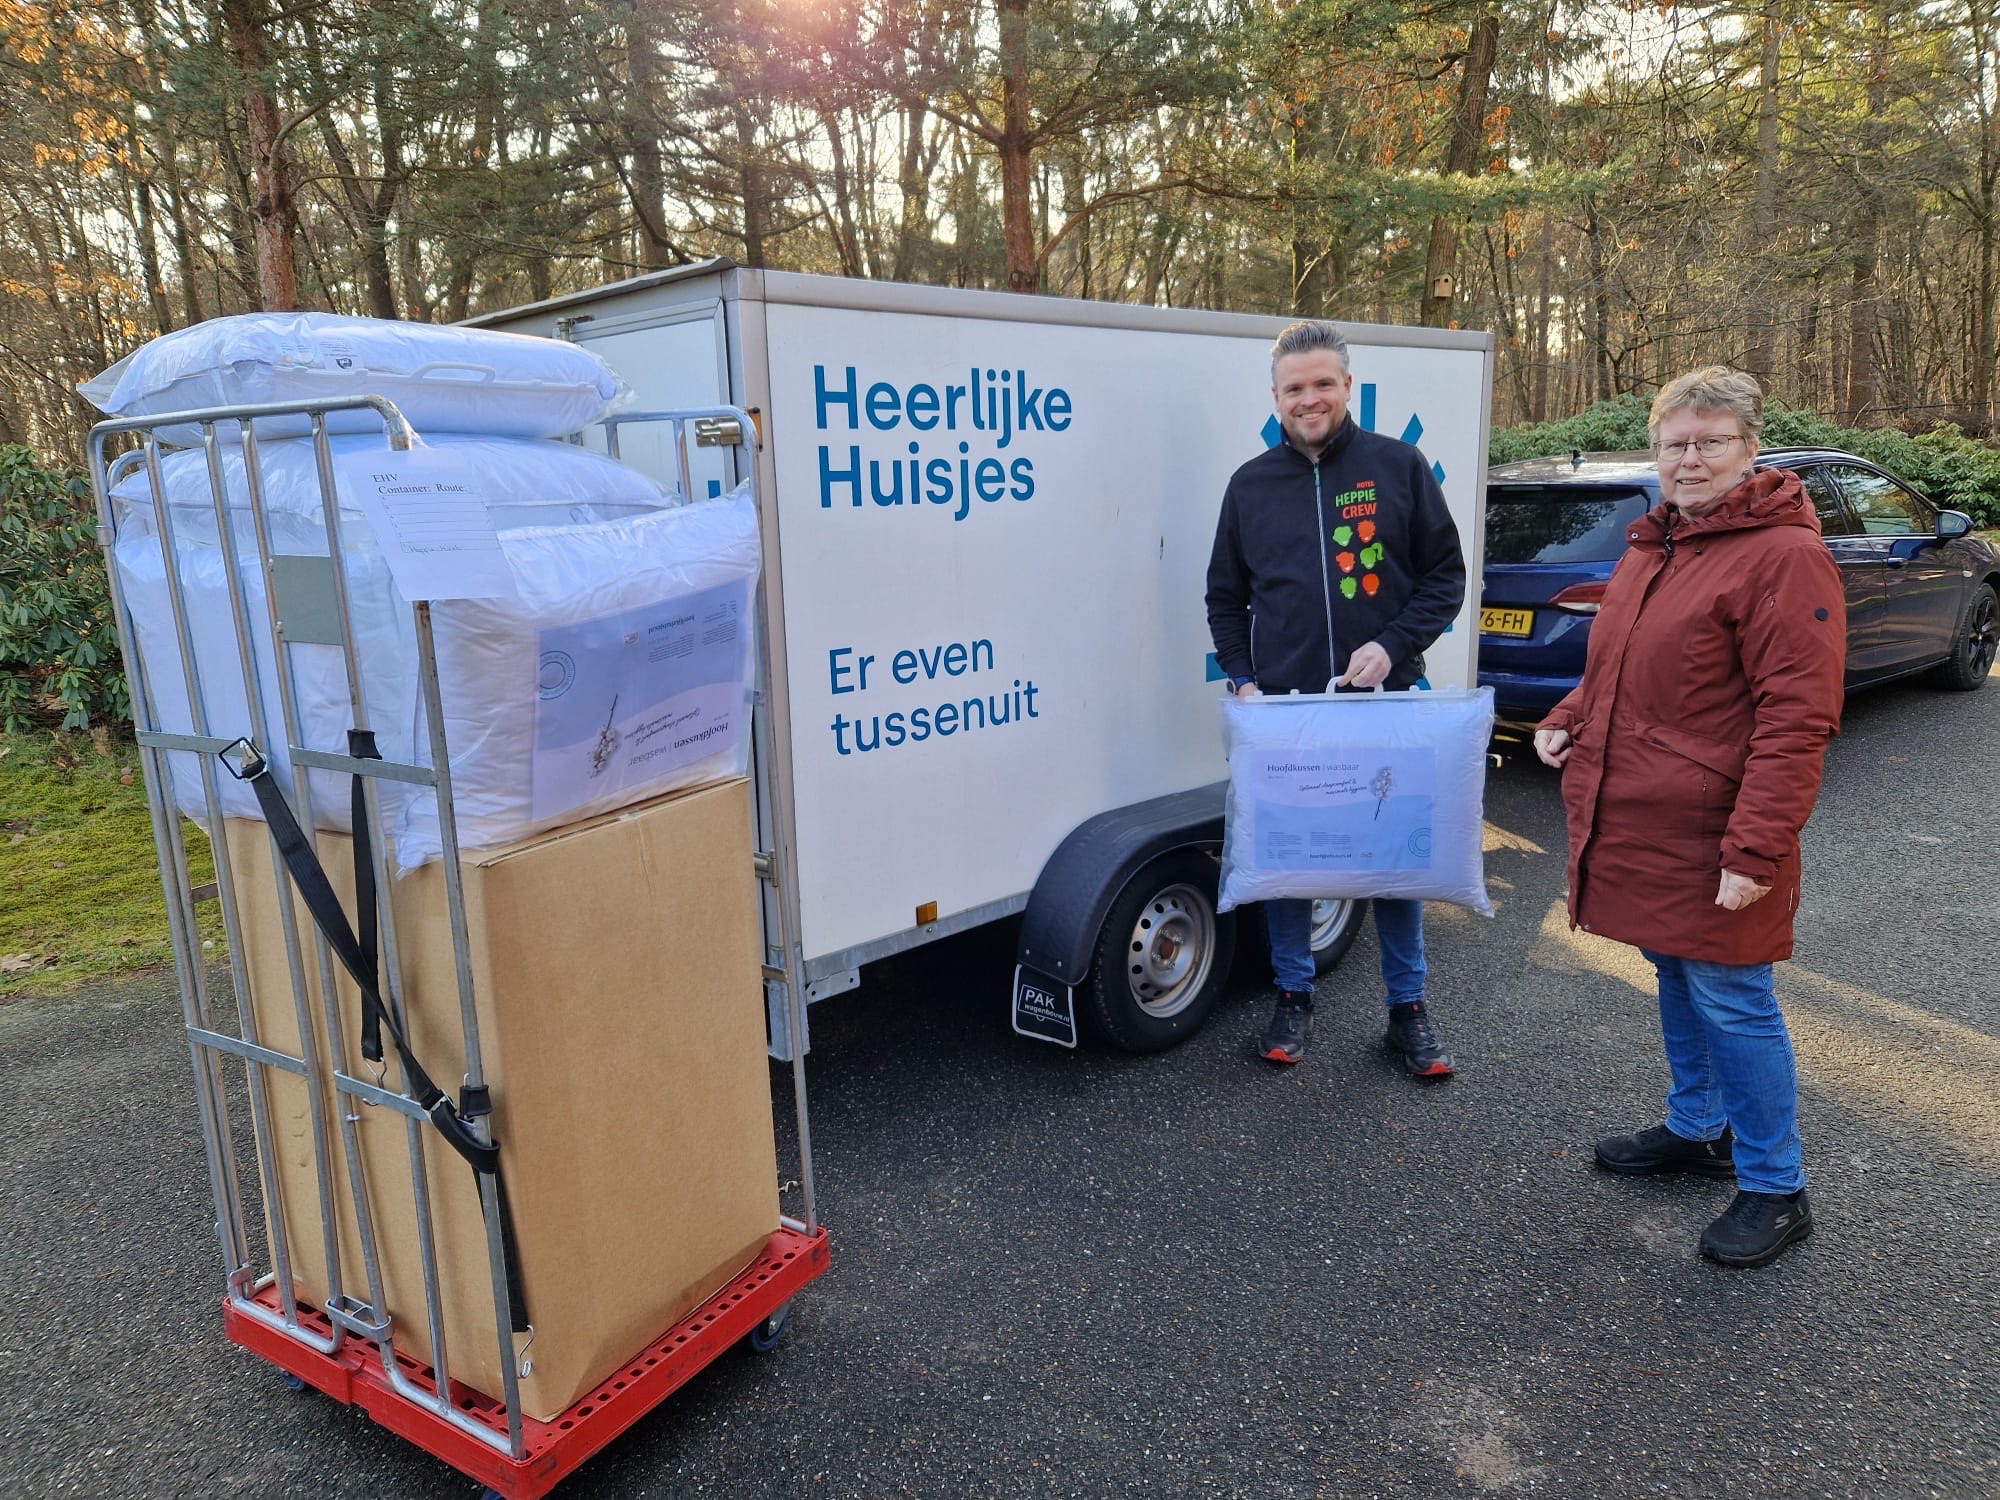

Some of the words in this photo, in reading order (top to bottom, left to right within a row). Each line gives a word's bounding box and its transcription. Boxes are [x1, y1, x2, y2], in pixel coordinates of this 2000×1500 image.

[814, 365, 1072, 449] Heerlijke
[372, 473, 398, 483] EHV
[818, 440, 1036, 522] Huisjes
[378, 485, 431, 495] Container:
[1335, 489, 1376, 507] HEPPIE
[1342, 503, 1377, 519] CREW
[829, 646, 875, 695] Er
[892, 639, 993, 686] even
[831, 680, 1040, 756] tussenuit
[674, 722, 729, 749] Hoofdkussen
[627, 745, 667, 767] wasbaar
[1267, 763, 1320, 774] Hoofdkussen
[1326, 763, 1360, 772] wasbaar
[1025, 989, 1055, 1009] PAK
[1024, 1003, 1070, 1023] wagenbouw.nl
